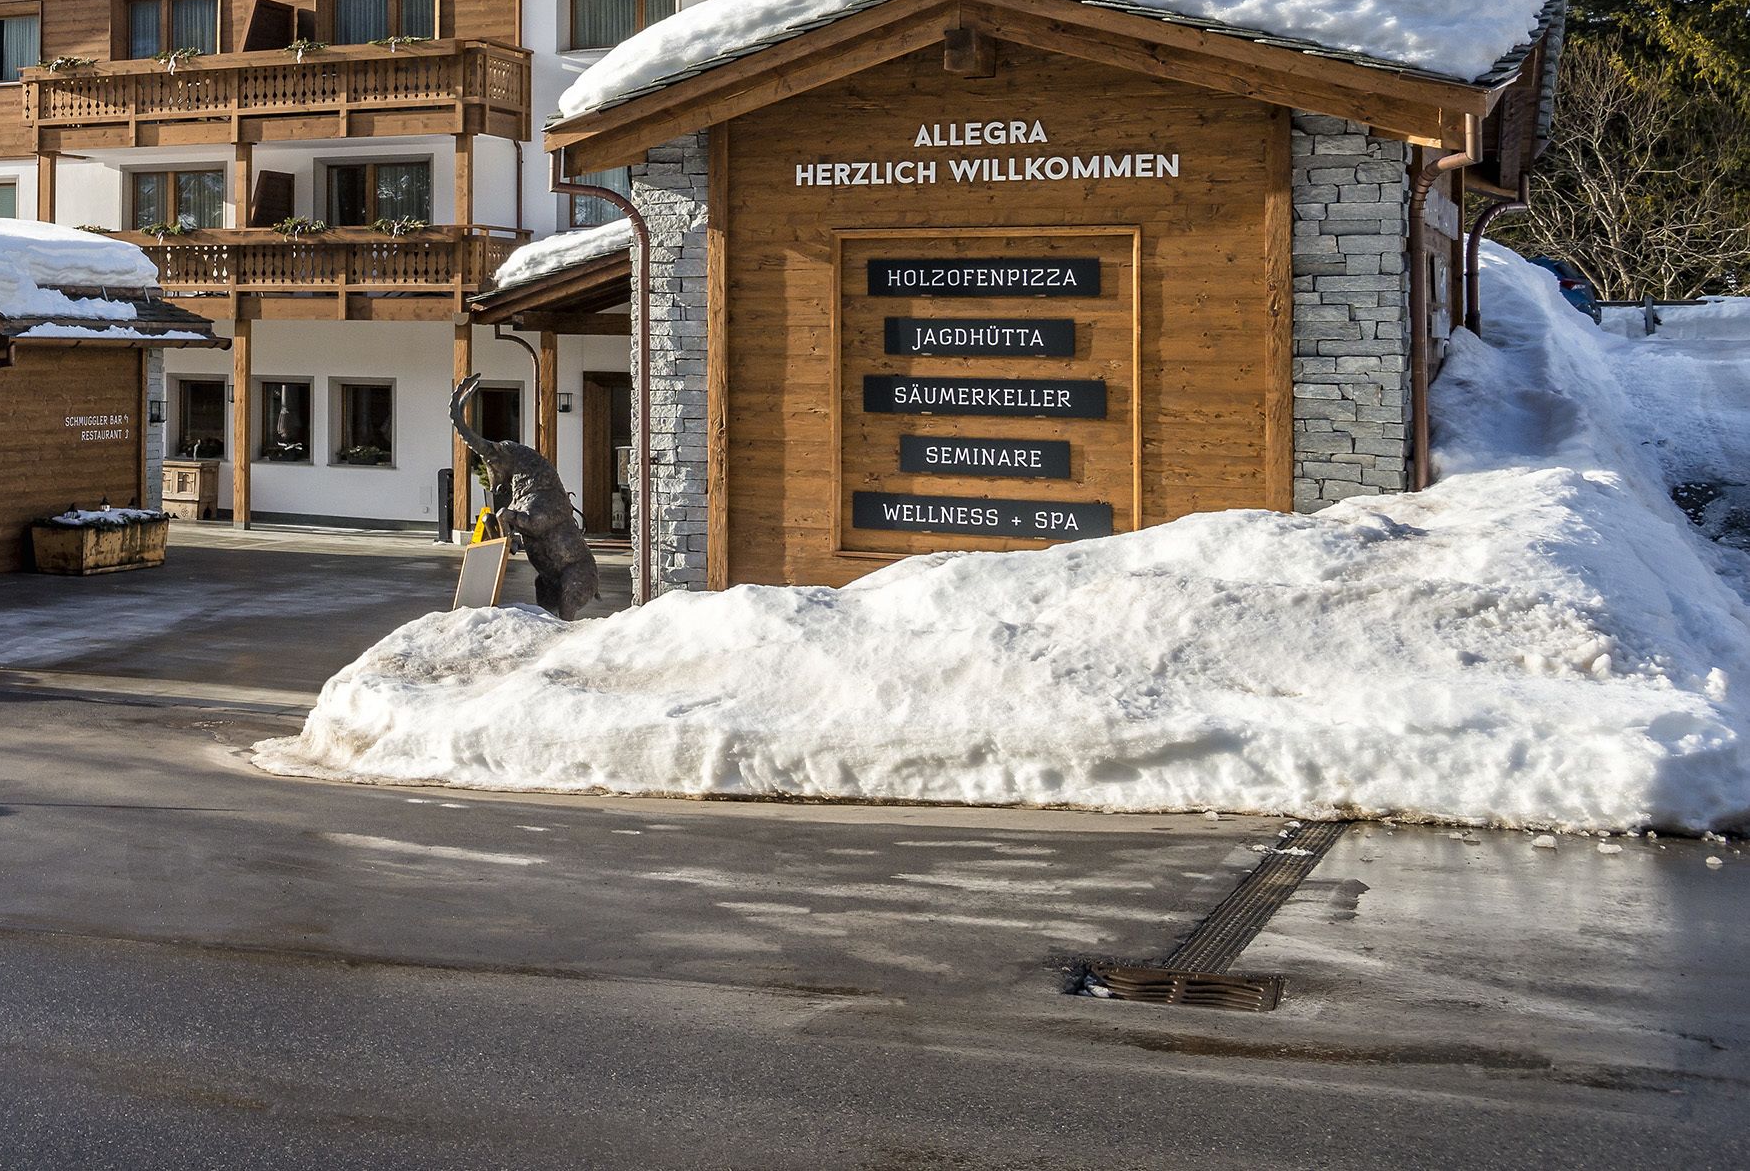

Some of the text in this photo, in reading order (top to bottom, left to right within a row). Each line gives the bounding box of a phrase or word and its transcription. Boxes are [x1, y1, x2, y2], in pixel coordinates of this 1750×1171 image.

[914, 120, 1048, 147] ALLEGRA
[795, 154, 1180, 186] HERZLICH WILLKOMMEN
[887, 268, 1078, 287] HOLZOFENPIZZA
[911, 325, 1044, 351] JAGDHÜTTA
[894, 384, 1072, 408] SÄUMERKELLER
[65, 414, 123, 427] SCHMUGGLER BAR
[81, 429, 123, 441] RESTAURANT
[925, 446, 1042, 468] SEMINARE
[883, 503, 999, 526] WELLNESS
[1034, 511, 1079, 531] SPA
